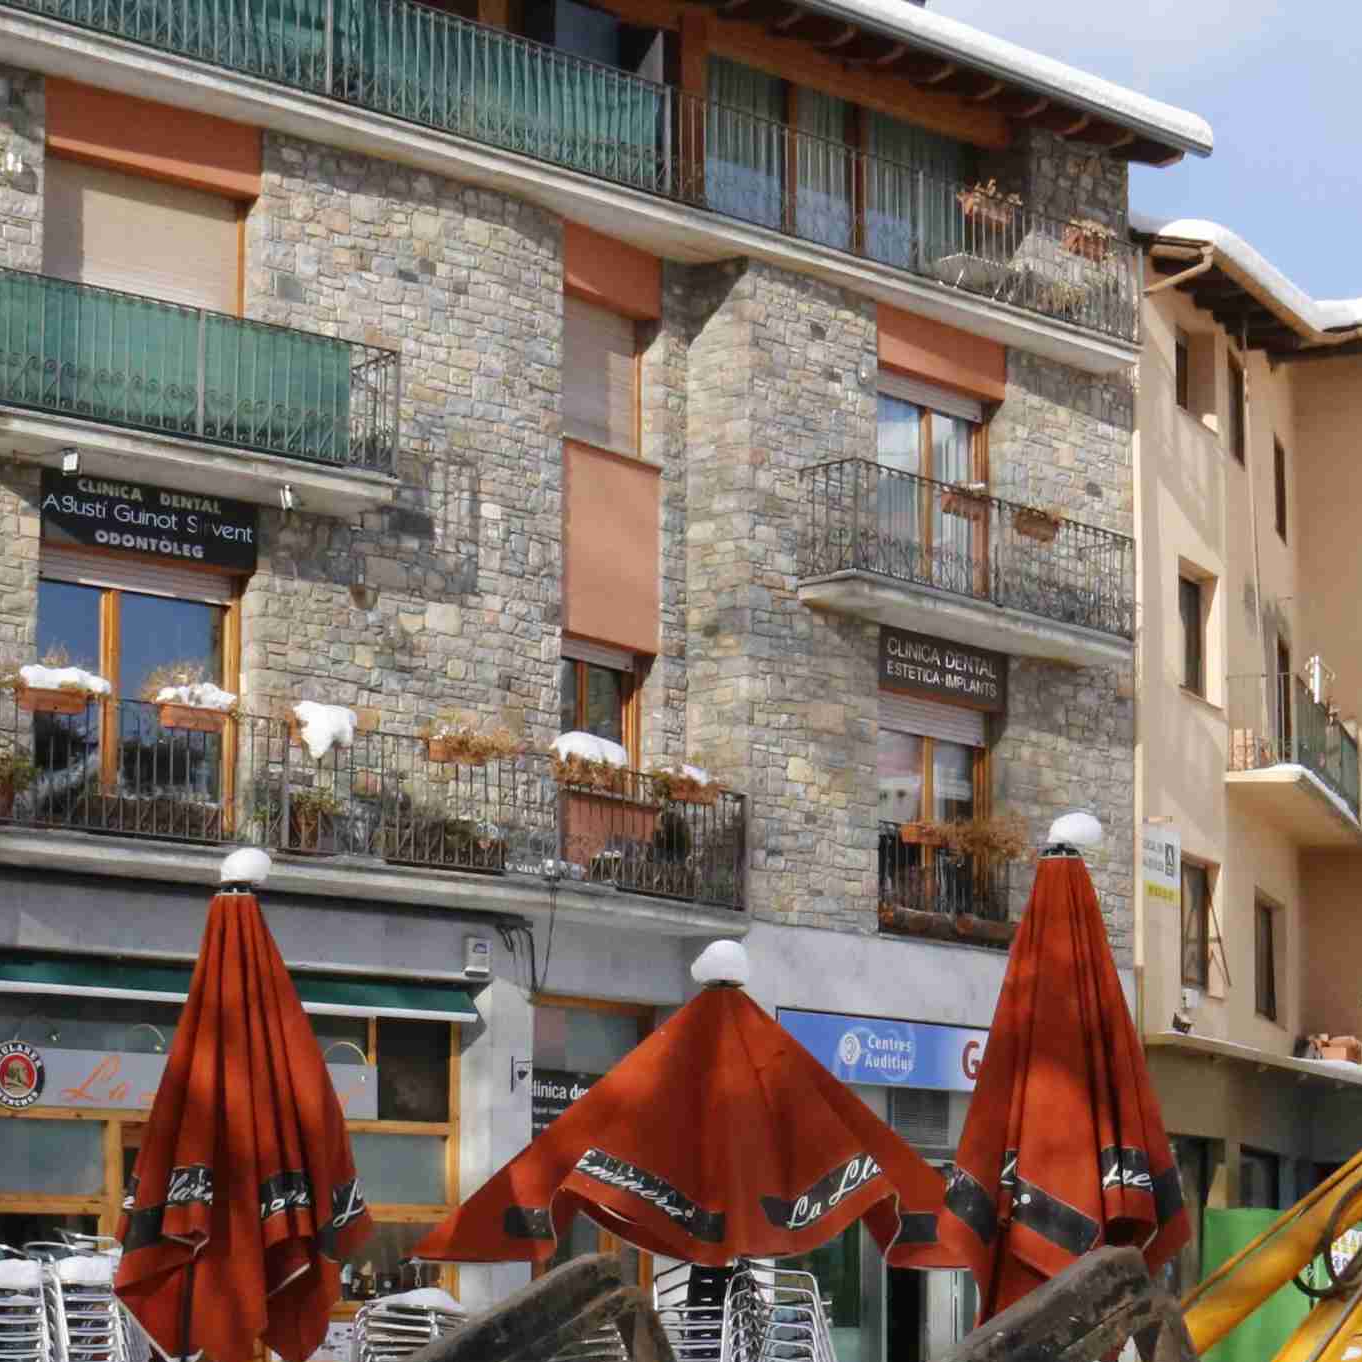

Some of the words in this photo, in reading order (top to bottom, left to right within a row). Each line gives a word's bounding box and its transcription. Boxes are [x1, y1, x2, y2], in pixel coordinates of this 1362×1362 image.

[113, 503, 178, 531] Guinot
[159, 492, 222, 515] DENTAL
[94, 529, 206, 559] ODONTÒLEG
[945, 649, 997, 679] DENTAL
[867, 1033, 912, 1053] Centres
[864, 1051, 915, 1072] Auditius
[786, 1194, 822, 1230] La
